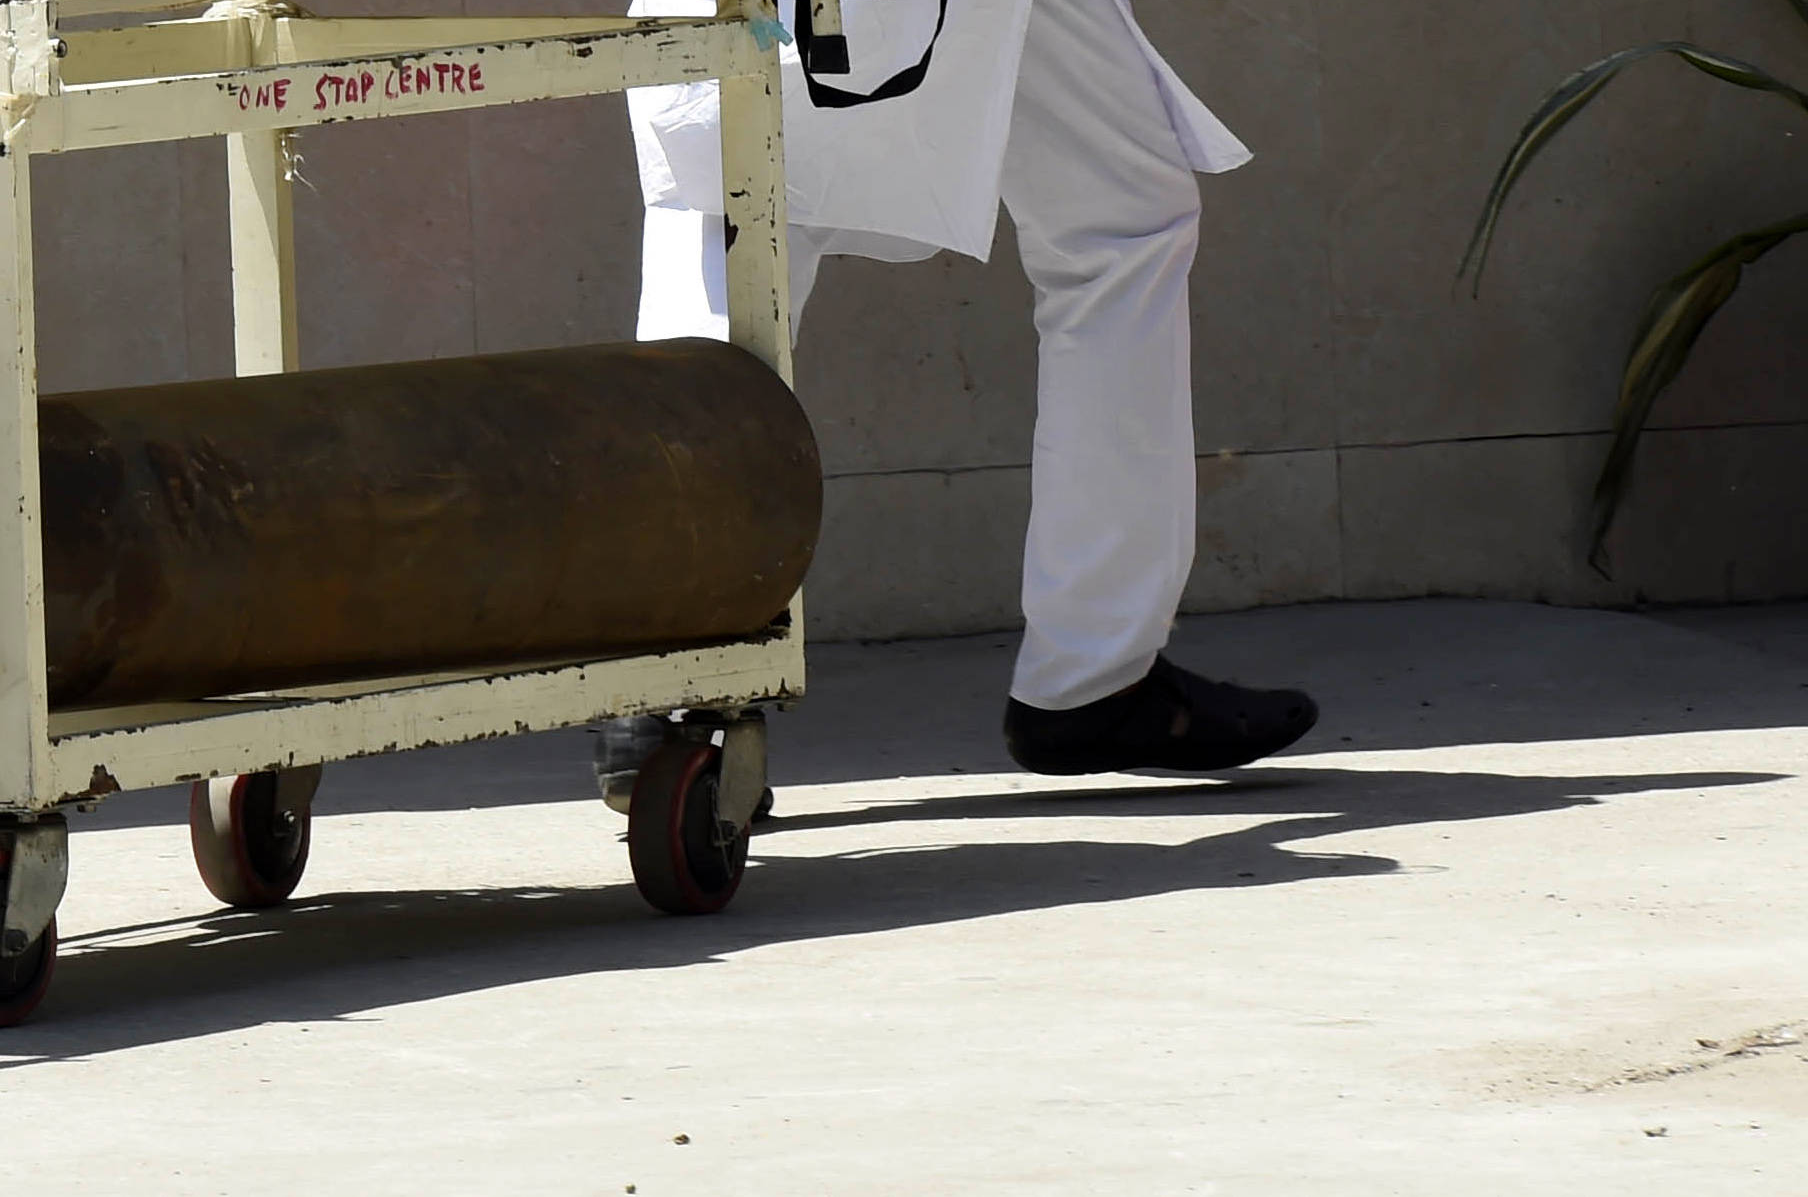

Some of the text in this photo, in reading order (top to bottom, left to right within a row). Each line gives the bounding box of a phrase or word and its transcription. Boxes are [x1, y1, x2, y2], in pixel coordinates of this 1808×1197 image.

[239, 62, 486, 112] ONE STOP CENTRE
